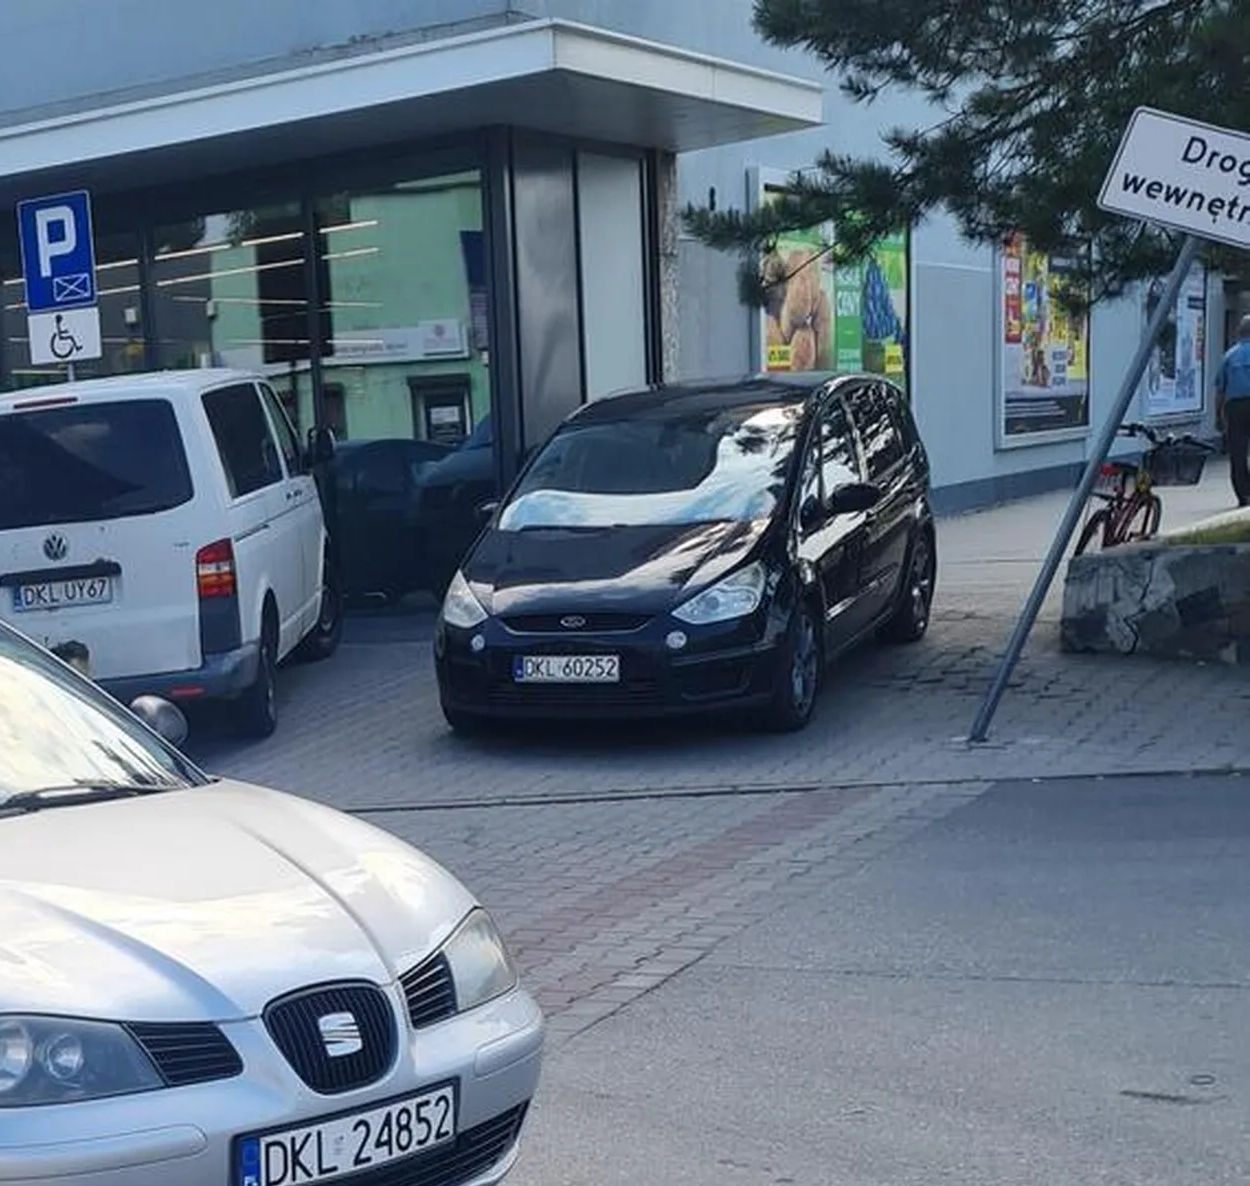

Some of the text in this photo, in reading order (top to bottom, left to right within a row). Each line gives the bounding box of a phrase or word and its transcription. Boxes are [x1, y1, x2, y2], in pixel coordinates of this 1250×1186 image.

[36, 206, 76, 277] P
[24, 579, 106, 606] DKL UY67
[525, 658, 616, 677] DKL 60252
[352, 1095, 450, 1166] 24852
